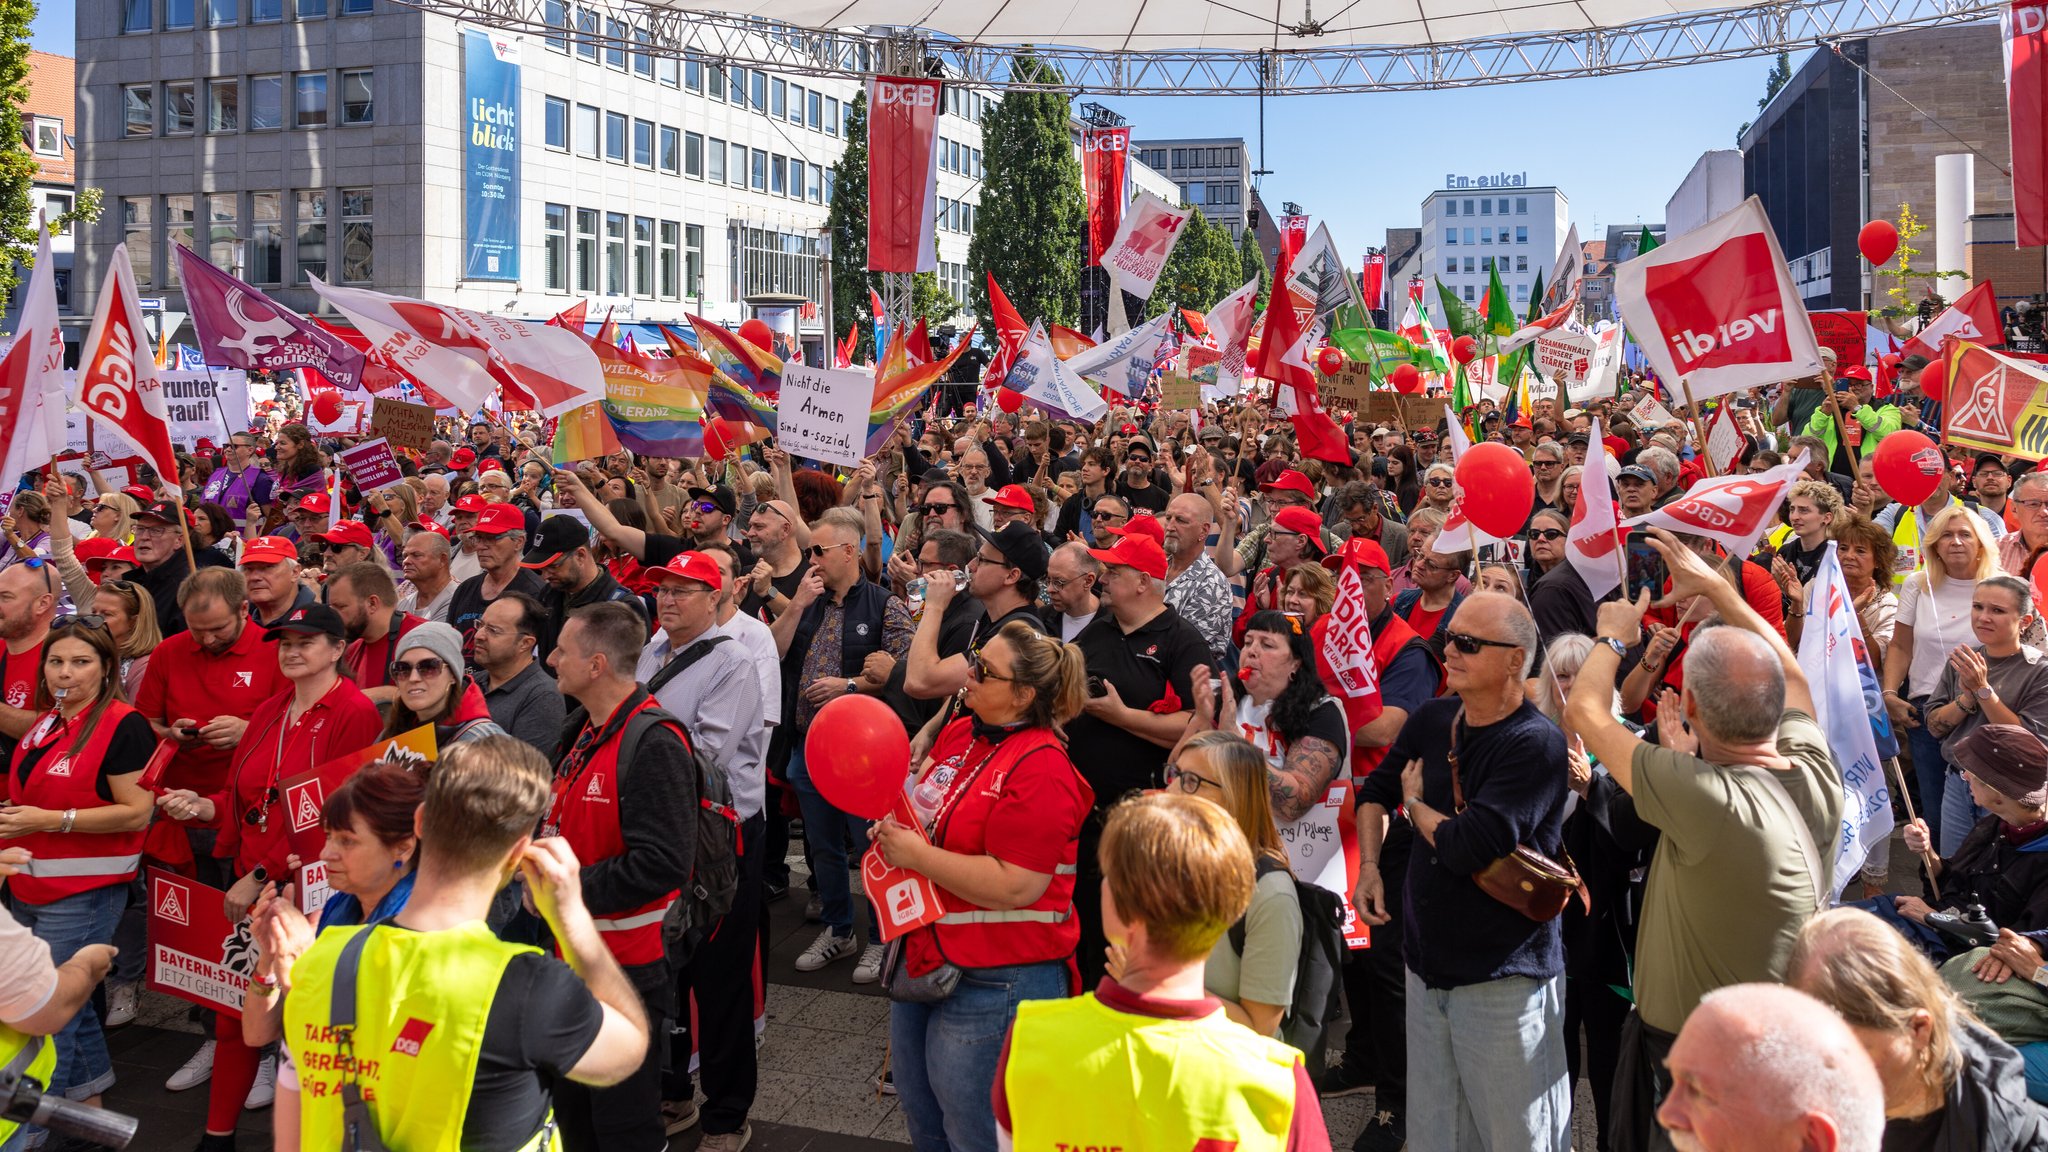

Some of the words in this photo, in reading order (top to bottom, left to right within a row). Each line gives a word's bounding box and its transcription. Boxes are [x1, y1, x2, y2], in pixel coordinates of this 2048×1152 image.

[879, 82, 936, 107] DGB
[472, 97, 515, 128] licht
[472, 121, 515, 151] blick
[1085, 134, 1126, 153] DGB
[482, 182, 504, 193] Sonntag
[1282, 219, 1307, 230] DGB
[1364, 256, 1383, 264] DGB
[1537, 336, 1591, 357] ZUSAMMENHALT
[1539, 345, 1549, 353] IST
[1548, 347, 1574, 361] UNSERE
[1349, 362, 1369, 376] WUT
[1540, 354, 1573, 372] STÄRKE!
[786, 373, 812, 390] Nicht
[812, 377, 831, 394] die
[800, 396, 844, 424] Armen
[780, 421, 798, 434] sind
[802, 428, 850, 450] a-sozial
[1330, 652, 1344, 670] UNS
[1341, 670, 1358, 690] DGB
[159, 967, 193, 987] JETZT
